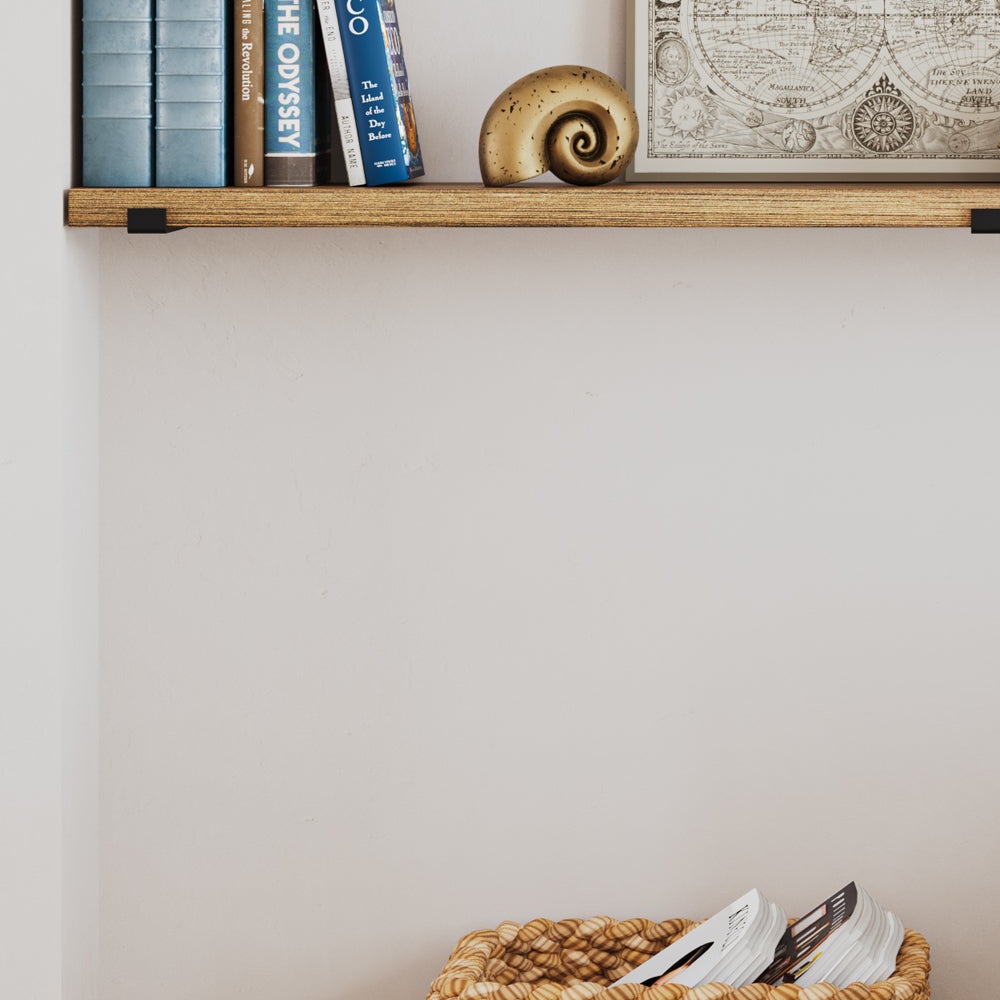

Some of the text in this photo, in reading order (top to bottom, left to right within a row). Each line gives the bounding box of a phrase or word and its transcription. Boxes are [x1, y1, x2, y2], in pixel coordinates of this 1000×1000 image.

[242, 28, 250, 40] the
[325, 26, 336, 42] END
[241, 42, 253, 101] Revolution
[361, 80, 378, 90] The
[277, 43, 301, 148] ODYSSEY
[361, 92, 384, 104] Island
[365, 106, 385, 116] of the
[369, 119, 386, 129] Day
[341, 115, 359, 169] AUTHOR NAME
[368, 131, 392, 142] Before
